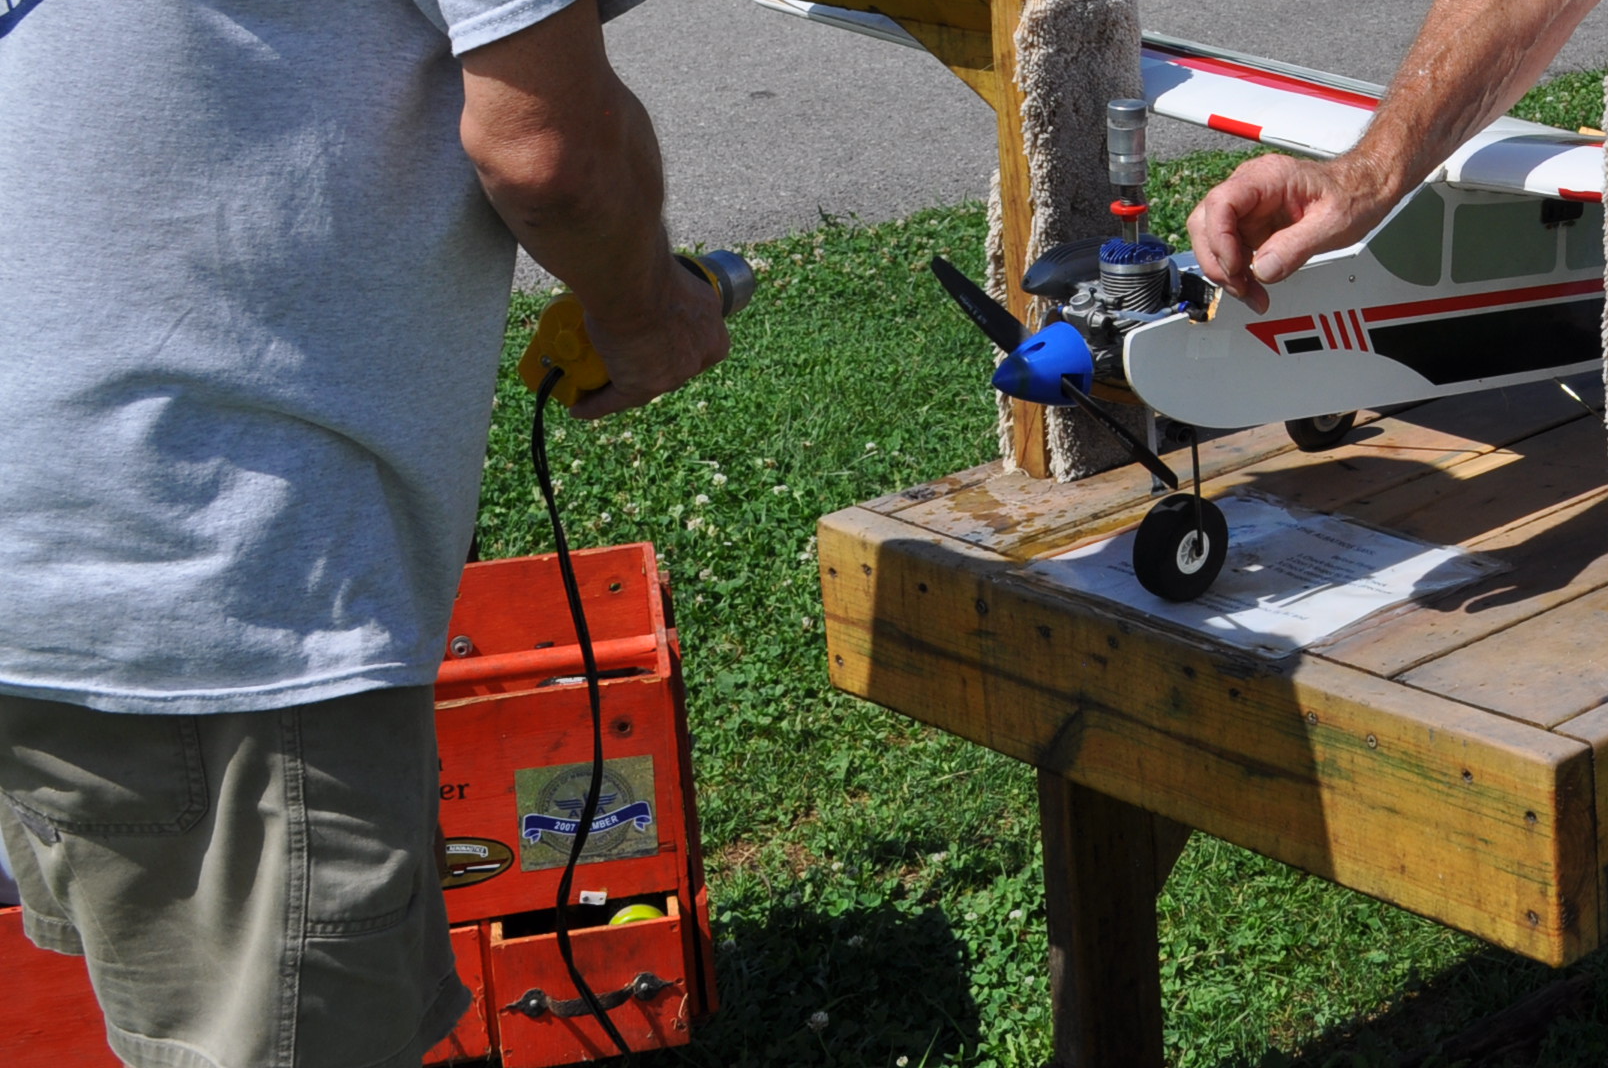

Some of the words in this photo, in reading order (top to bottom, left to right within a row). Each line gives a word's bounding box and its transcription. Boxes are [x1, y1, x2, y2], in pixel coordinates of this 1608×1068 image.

[568, 807, 606, 819] AA
[554, 822, 576, 832] 2007
[589, 815, 619, 832] MBER
